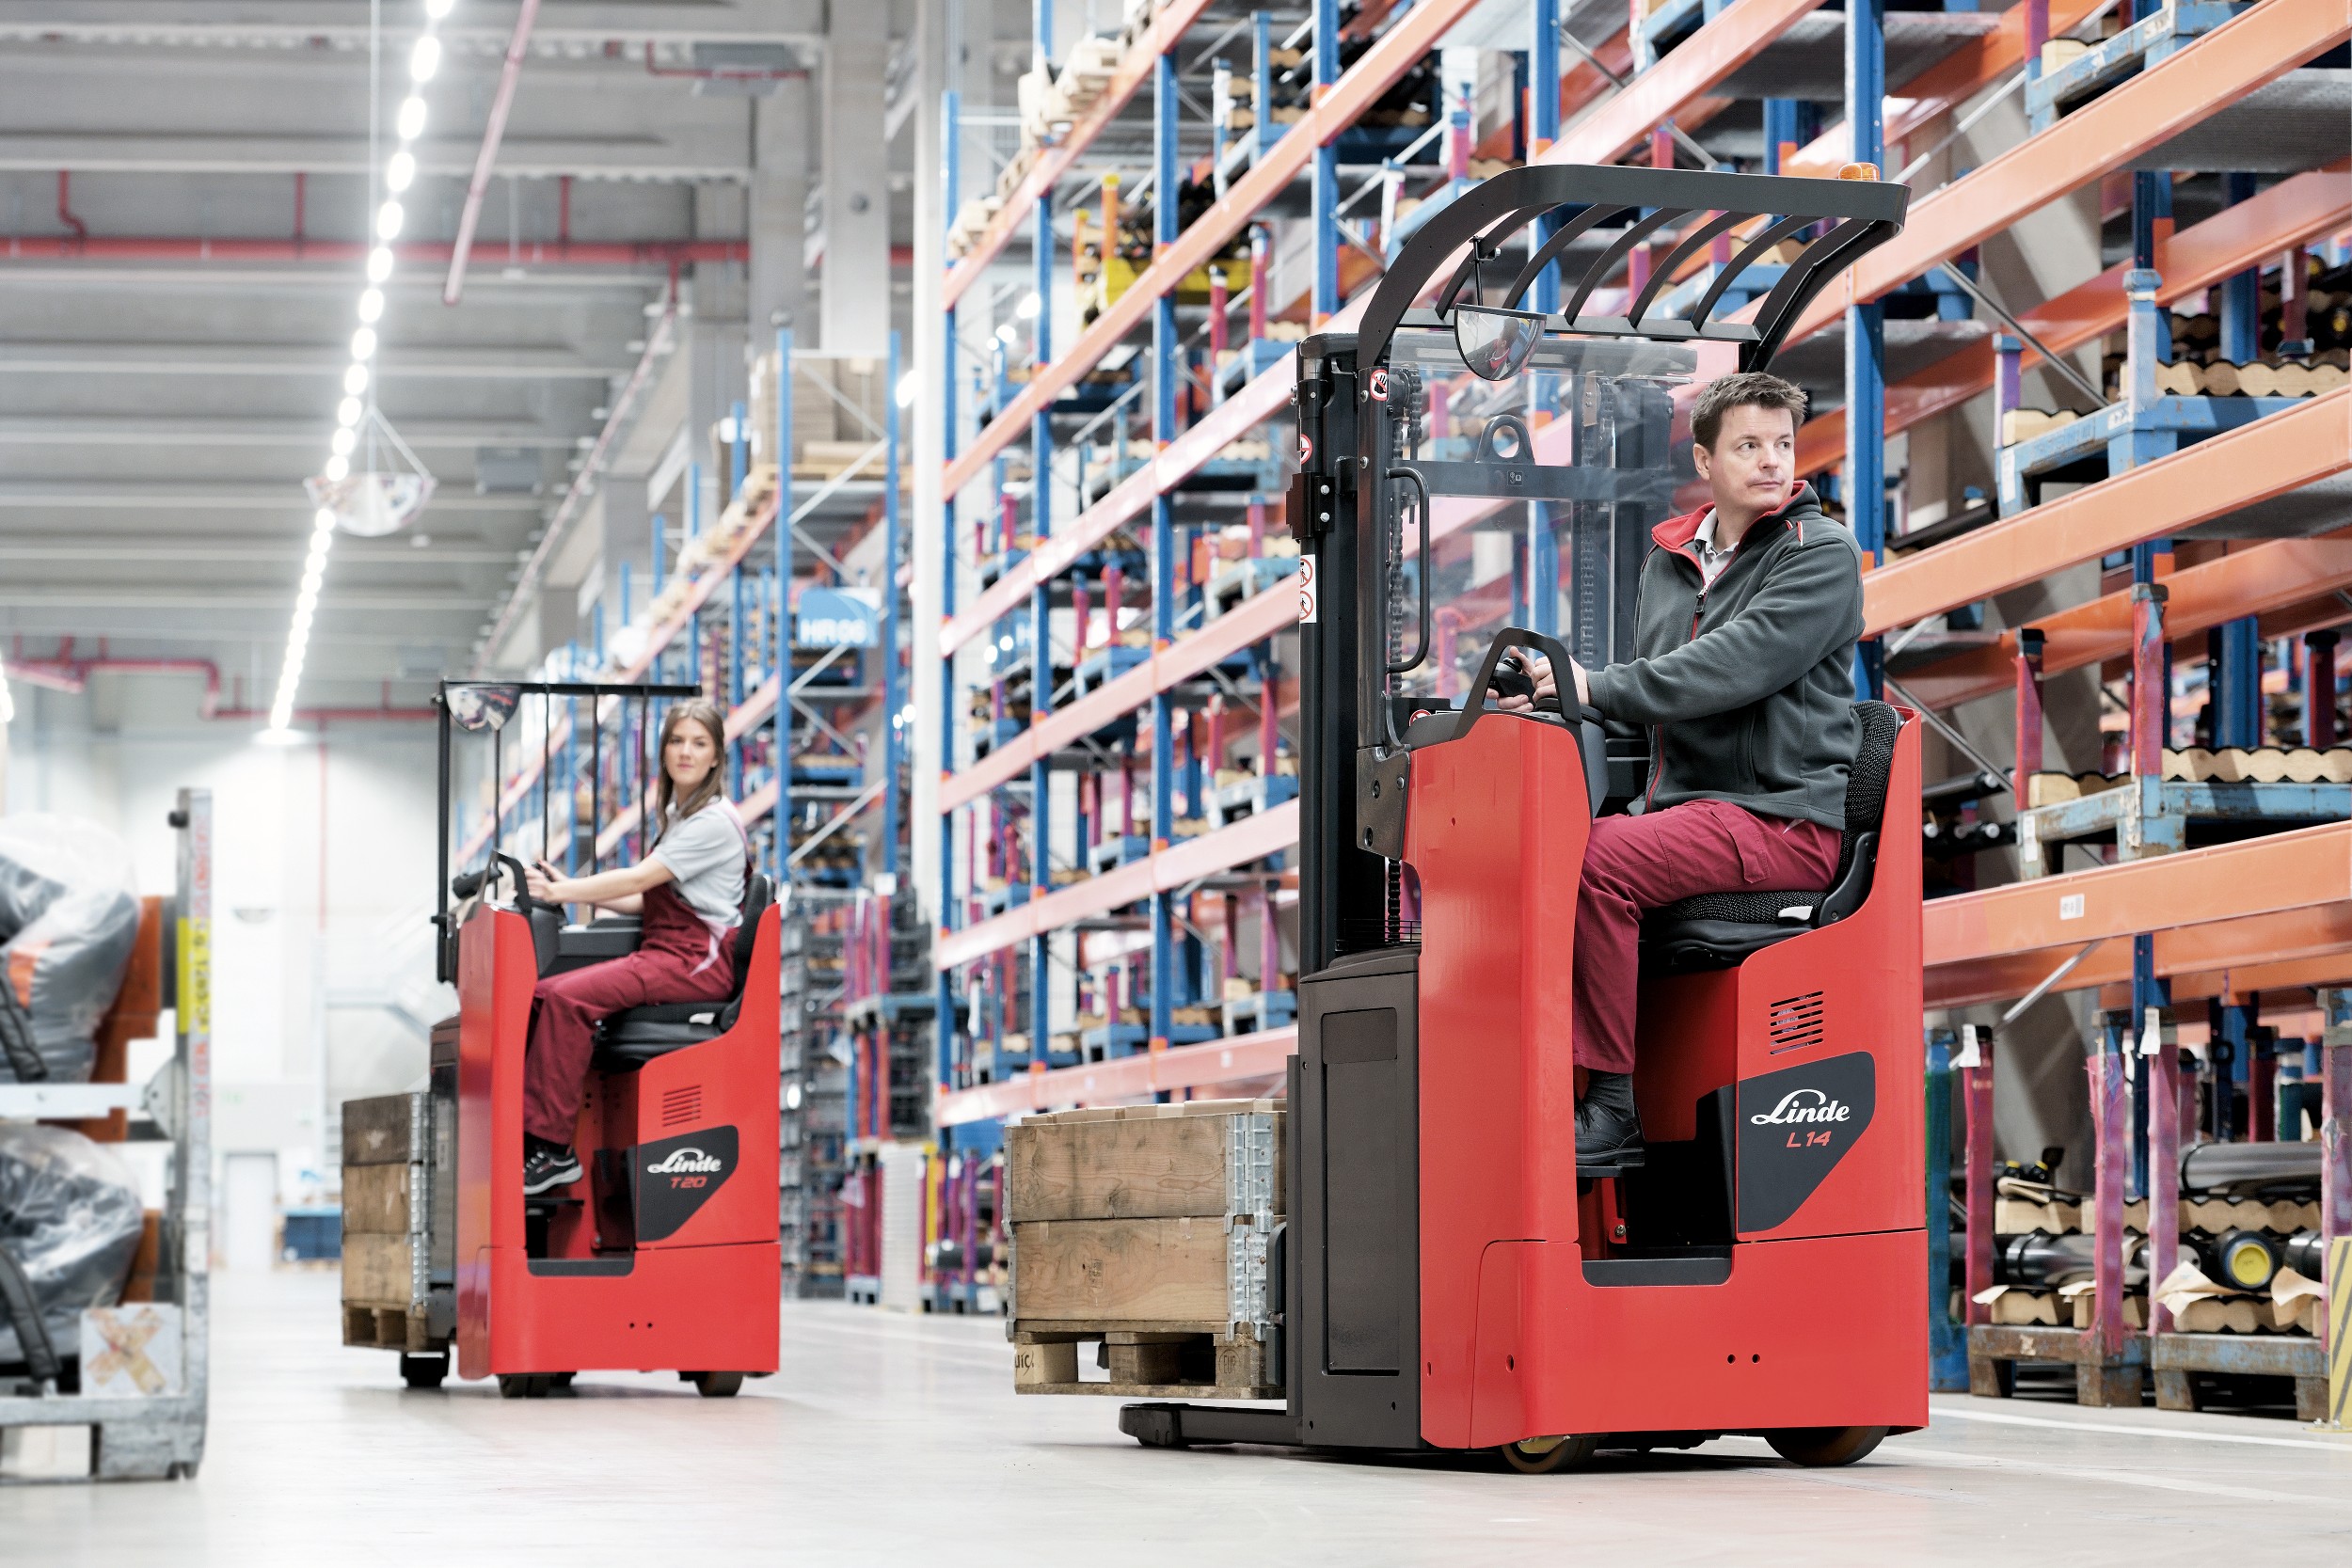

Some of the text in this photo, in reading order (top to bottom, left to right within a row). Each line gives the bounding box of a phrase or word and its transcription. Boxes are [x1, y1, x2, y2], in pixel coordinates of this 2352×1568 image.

[1751, 1088, 1851, 1125] Linde
[1805, 1131, 1832, 1148] 14
[647, 1147, 722, 1174] Linde
